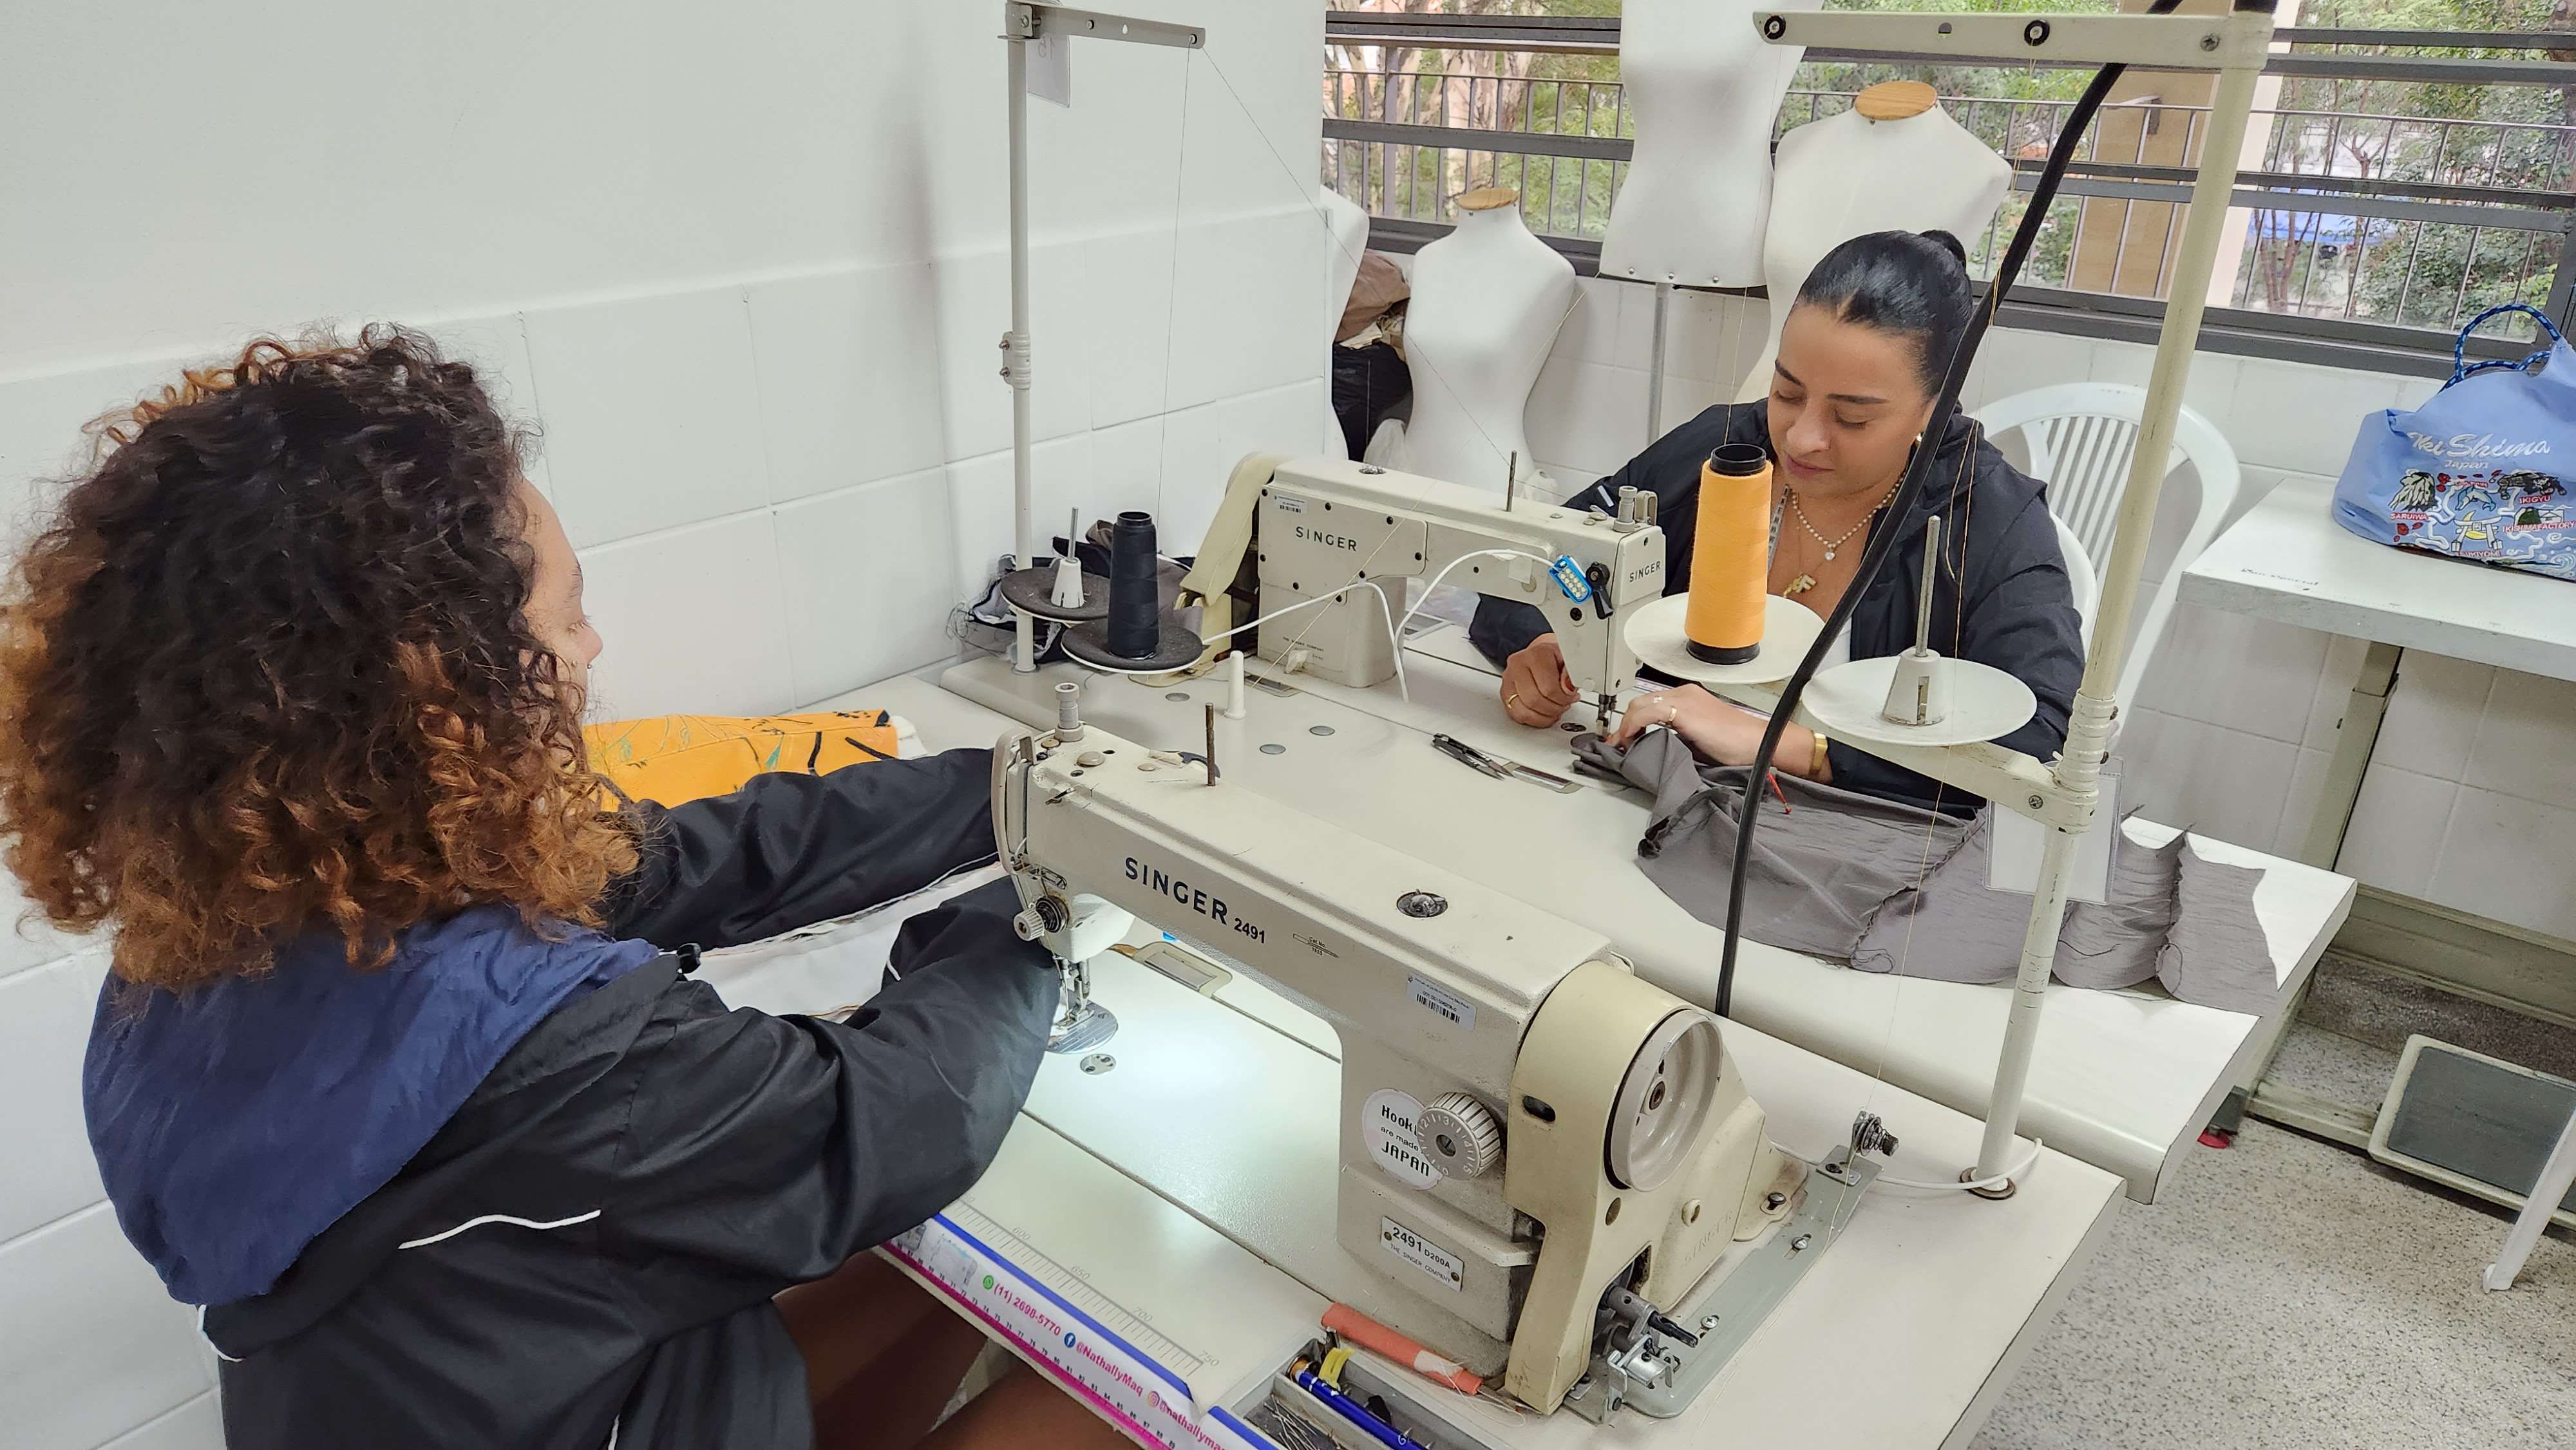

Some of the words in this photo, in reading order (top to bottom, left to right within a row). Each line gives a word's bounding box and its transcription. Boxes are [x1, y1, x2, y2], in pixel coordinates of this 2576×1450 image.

[2447, 433, 2551, 458] Shima
[2444, 459, 2489, 470] Japan
[2519, 495, 2551, 505] IKIGYU
[2390, 512, 2428, 521] SARUIWA
[1295, 525, 1358, 552] SINGER
[1629, 560, 1661, 583] SINGER
[1125, 857, 1227, 926] SINGER
[1234, 918, 1266, 944] 2491
[1443, 1116, 1450, 1125] 3
[1380, 1125, 1394, 1136] are
[1396, 1135, 1419, 1151] made
[1392, 1227, 1422, 1252] 2491
[1424, 1249, 1451, 1269] D200A
[1391, 1244, 1400, 1254] THE
[1403, 1252, 1423, 1267] SINGER
[1425, 1265, 1452, 1283] COMPANY
[994, 1283, 1012, 1304] (11)
[1013, 1297, 1061, 1336] 2698-5770
[1012, 1227, 1031, 1241] 600
[1070, 1265, 1091, 1279] 650
[1132, 1306, 1153, 1322] 700
[1198, 1349, 1220, 1367] 750
[1075, 1341, 1144, 1397] @NathallyMaq
[1160, 1398, 1226, 1450] @nathallyma
